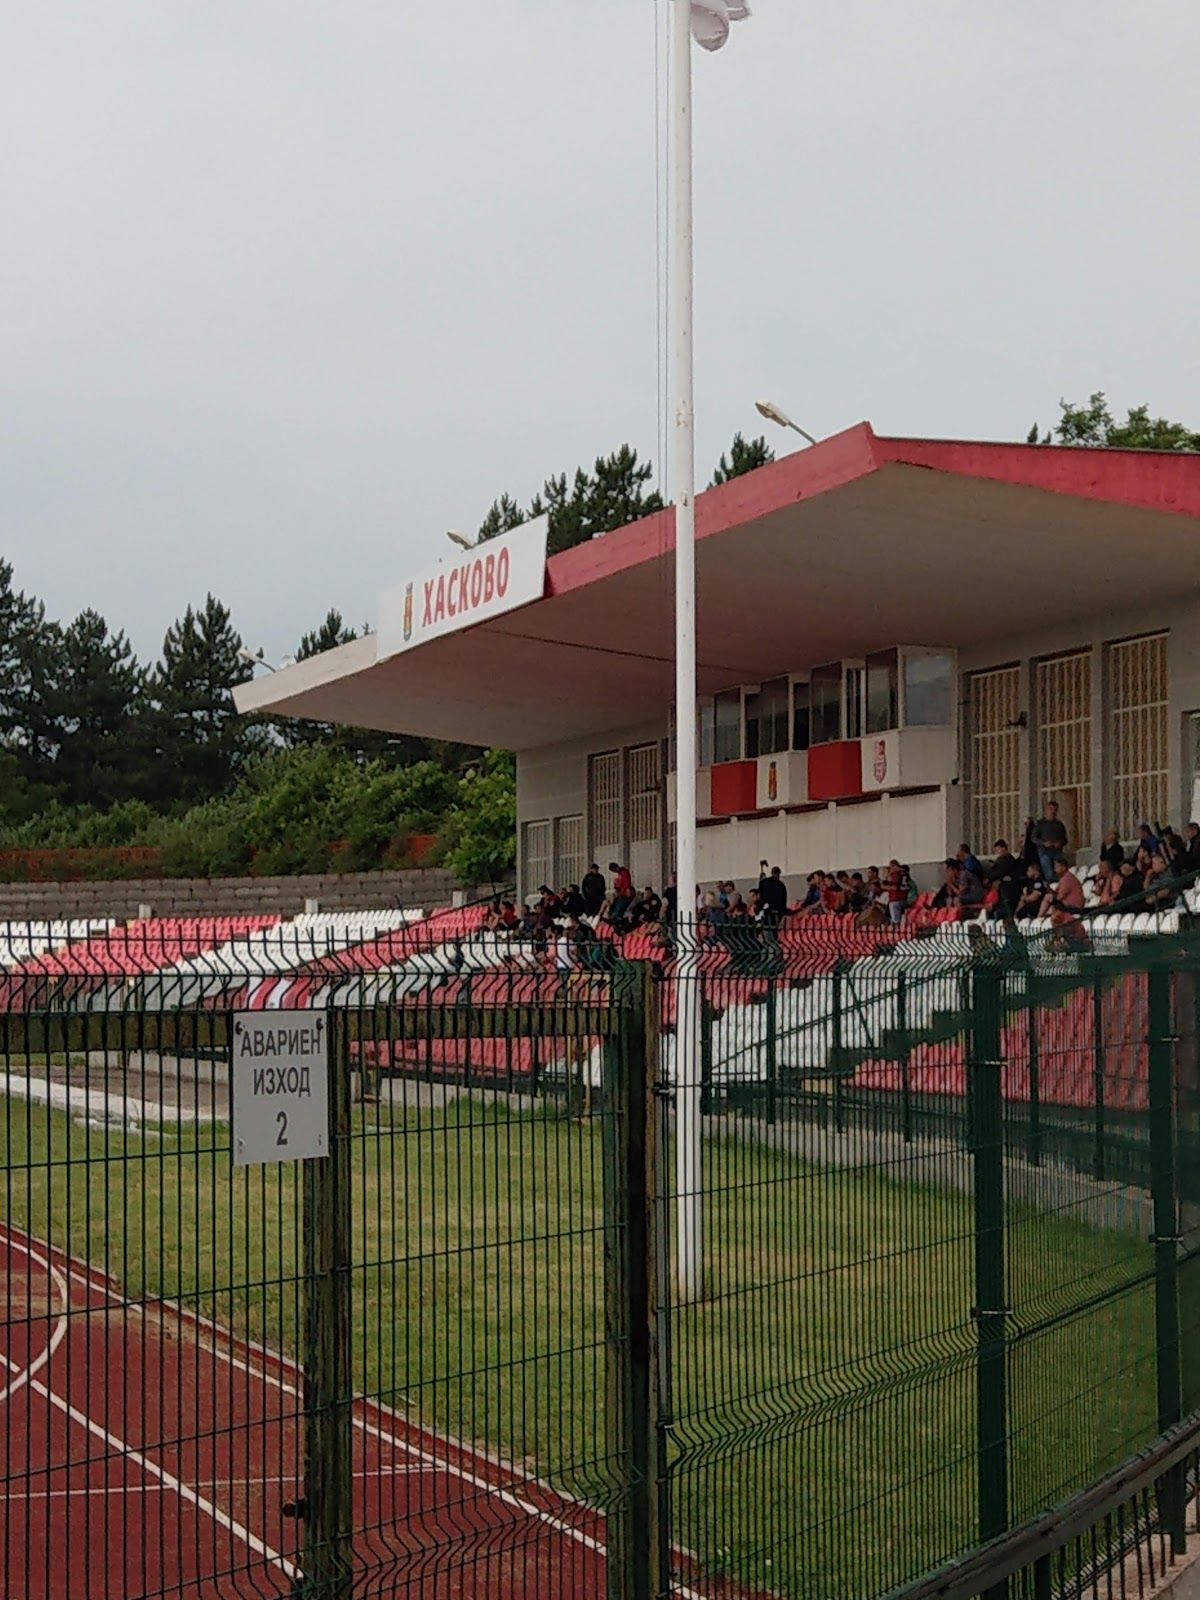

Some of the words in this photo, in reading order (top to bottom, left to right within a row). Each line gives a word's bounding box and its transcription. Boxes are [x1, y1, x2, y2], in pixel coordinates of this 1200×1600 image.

[422, 547, 509, 627] ХАСКОВО
[240, 1029, 321, 1057] АВАРИЕН
[253, 1067, 310, 1097] ИЗХОД
[276, 1111, 288, 1146] 2
